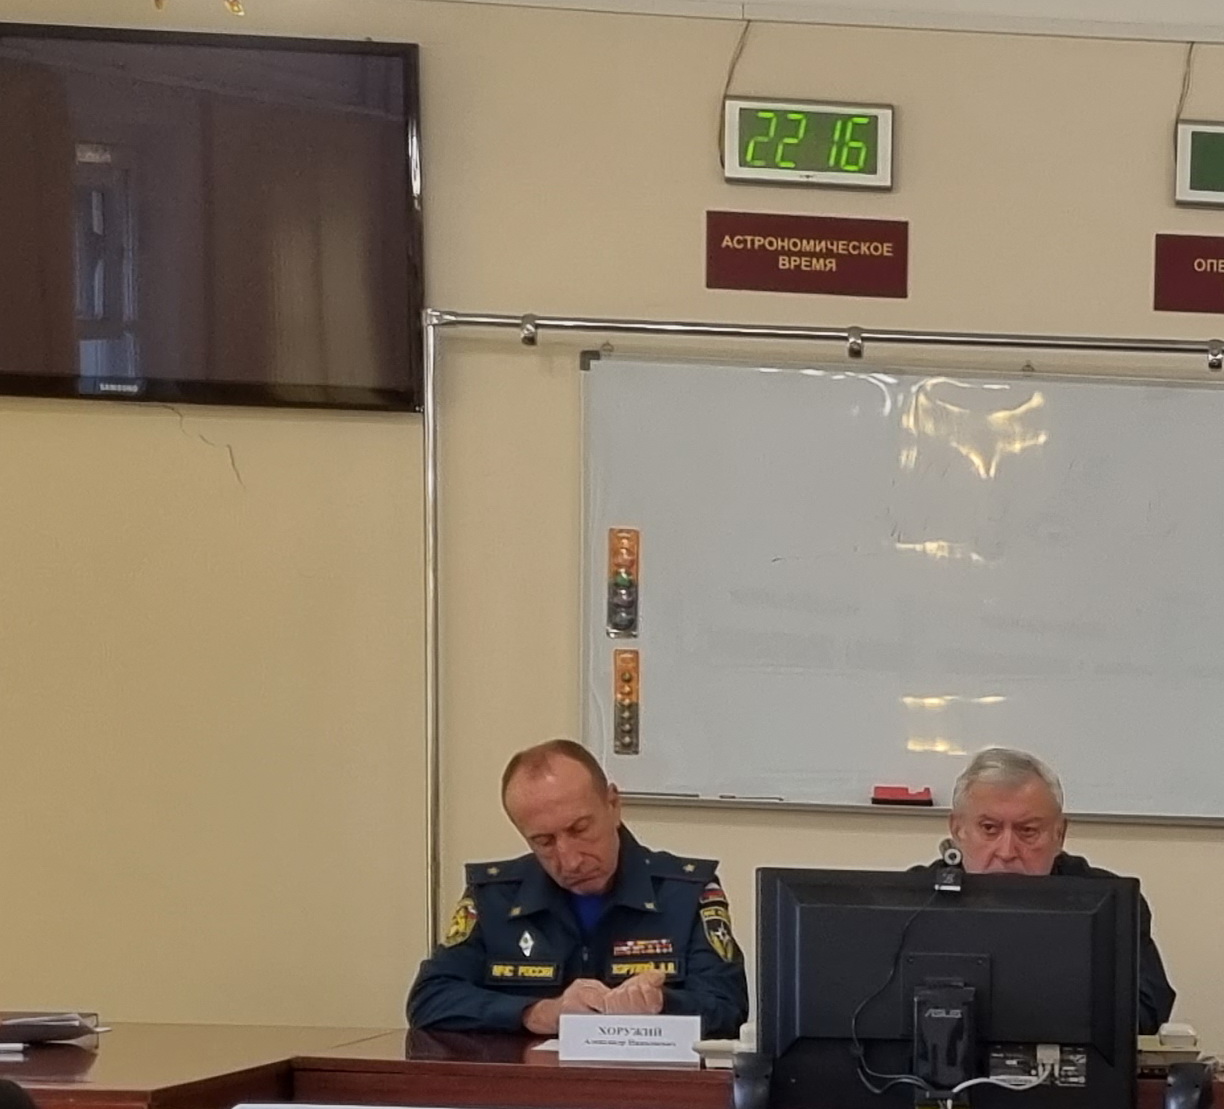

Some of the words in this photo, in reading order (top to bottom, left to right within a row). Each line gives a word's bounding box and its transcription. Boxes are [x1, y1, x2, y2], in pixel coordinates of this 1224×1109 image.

[721, 234, 894, 257] АСТРОНОМИЧЕСКОЕ
[778, 256, 837, 272] ВРЕМЯ
[99, 382, 138, 392] SAMSUNG
[924, 1008, 962, 1018] ASUS
[597, 1026, 663, 1037] ХОРУЖИЙ
